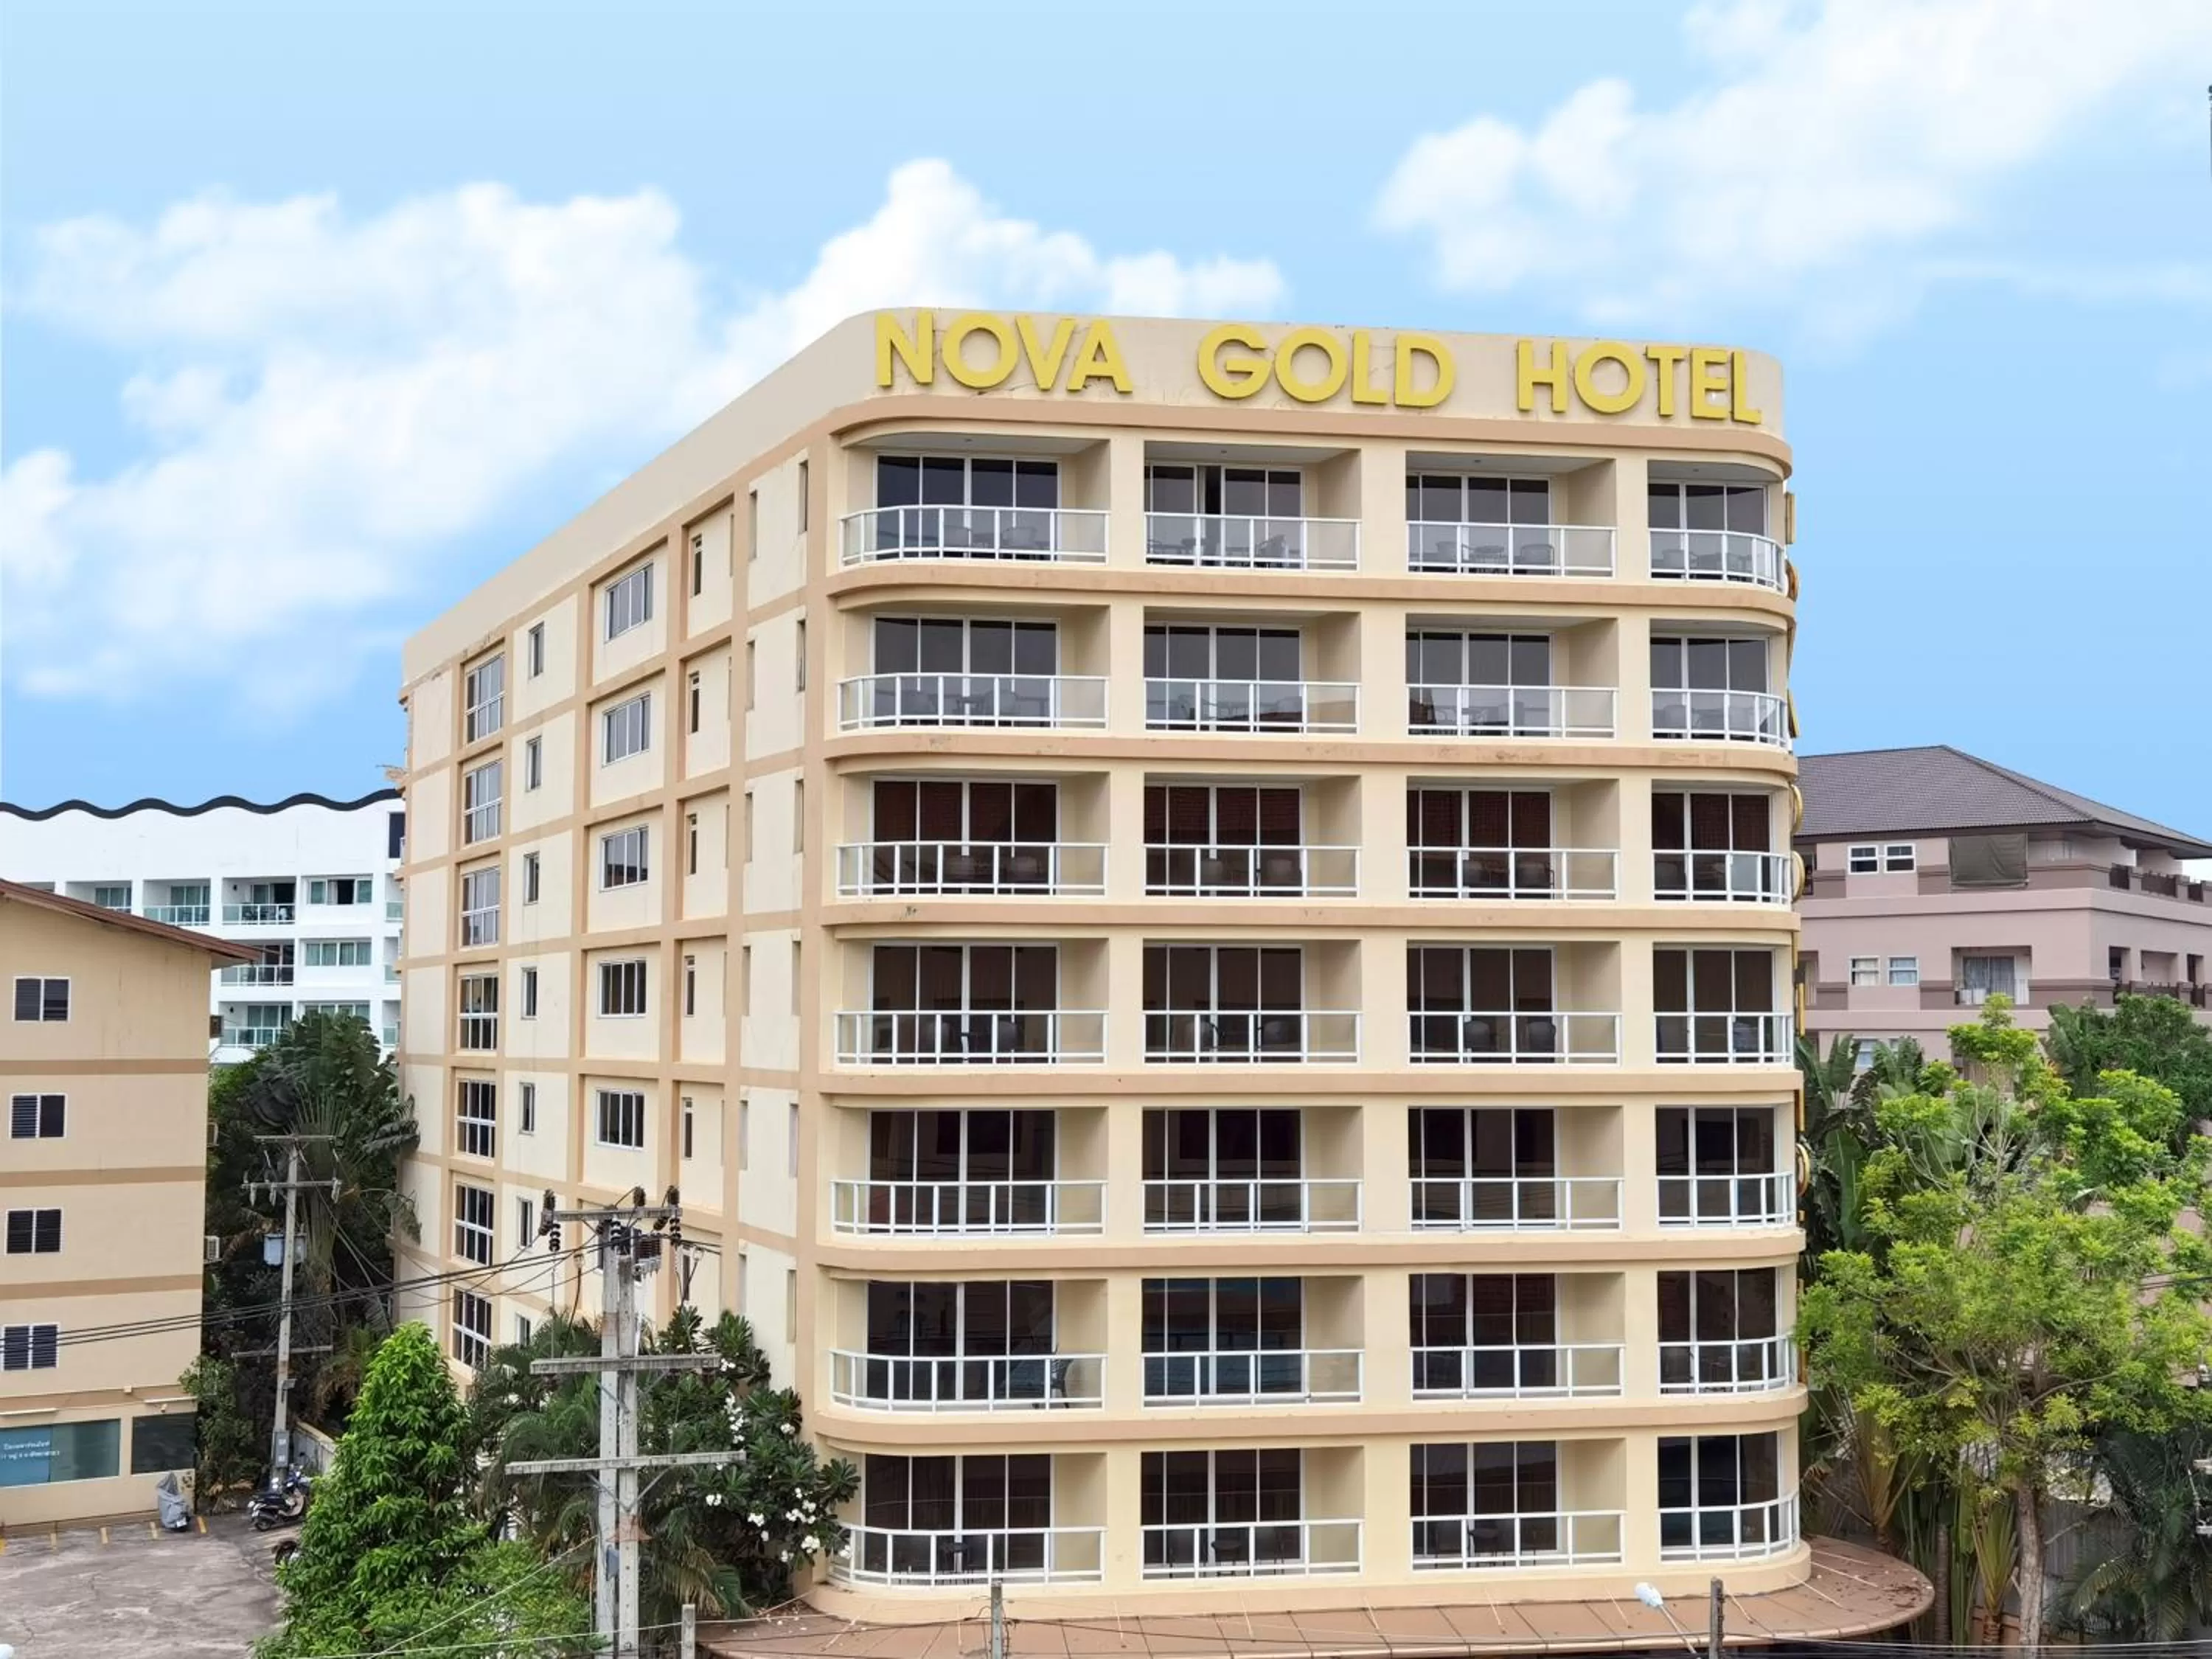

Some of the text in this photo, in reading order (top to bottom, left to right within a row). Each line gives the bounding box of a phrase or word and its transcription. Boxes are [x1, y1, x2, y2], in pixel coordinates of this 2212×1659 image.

[874, 310, 1761, 424] NOVA GOLD HOTEL
